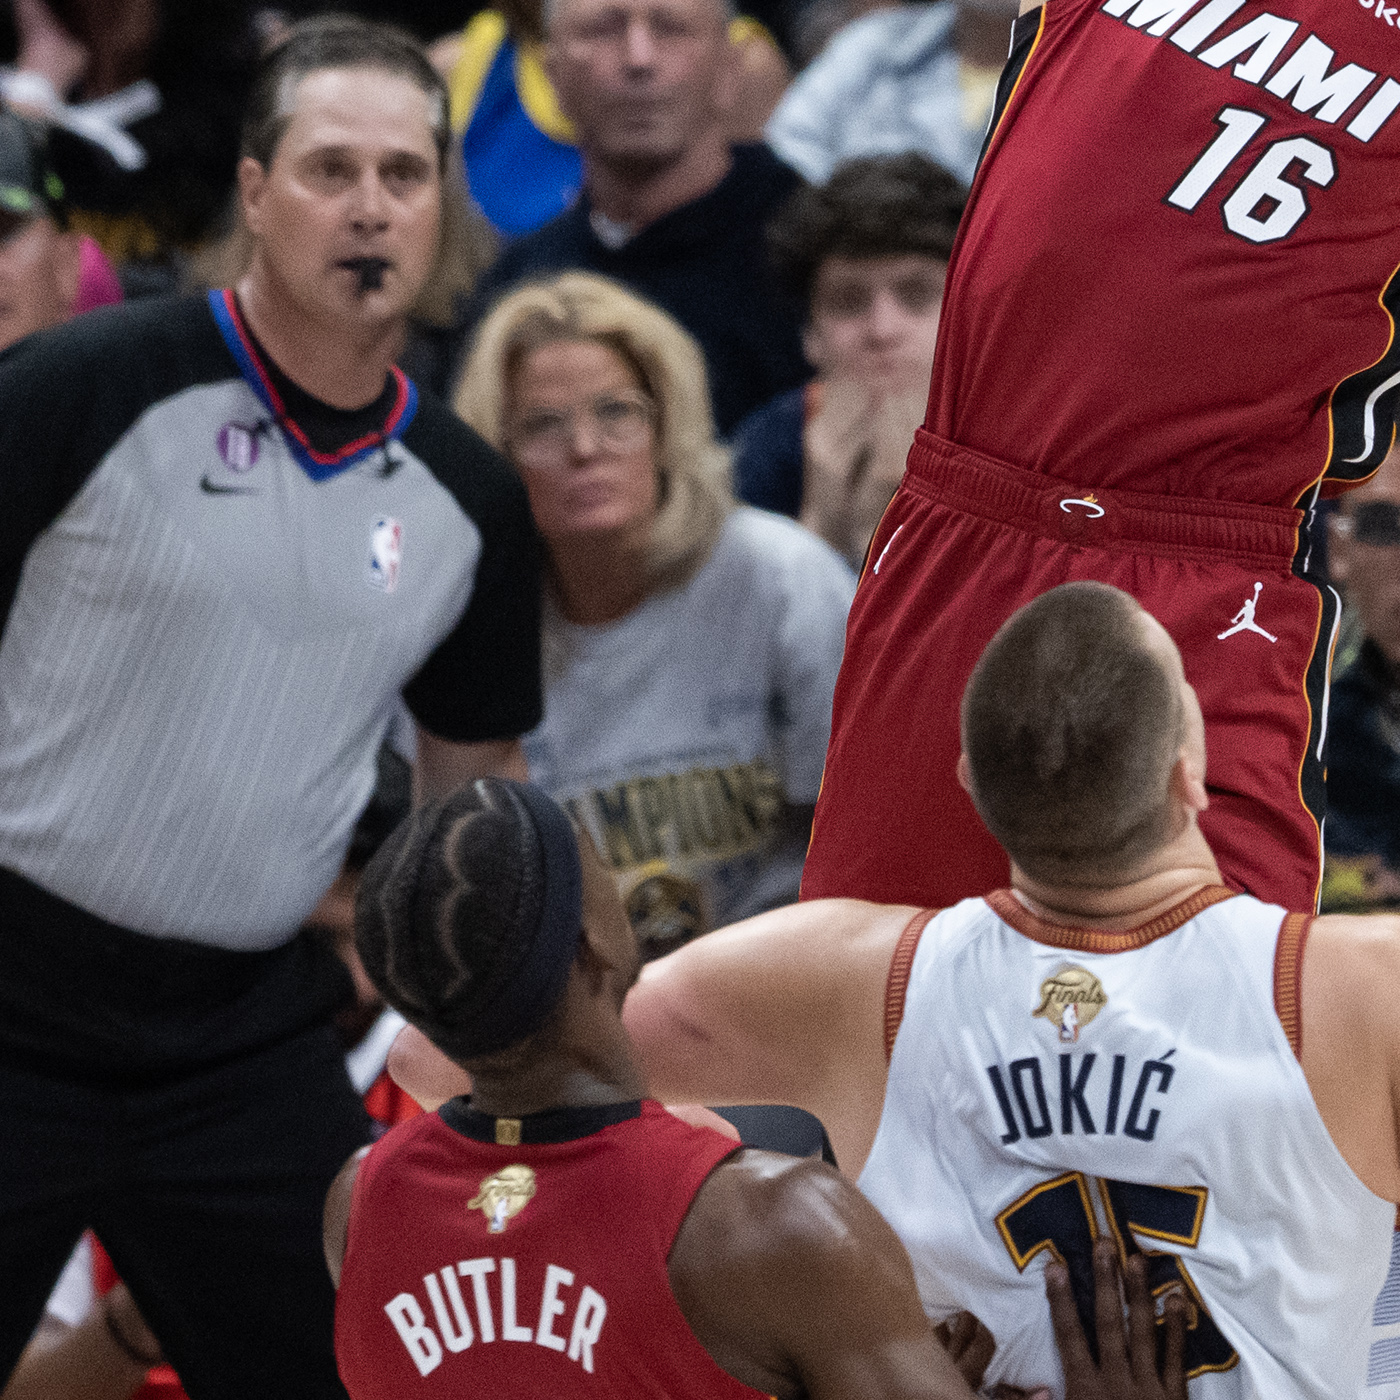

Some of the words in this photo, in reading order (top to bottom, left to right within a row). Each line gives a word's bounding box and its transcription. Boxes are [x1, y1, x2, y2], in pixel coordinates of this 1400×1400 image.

[1161, 104, 1340, 245] 16
[1032, 976, 1107, 1018] Finals
[986, 1047, 1177, 1145] JOKIĆ
[383, 1256, 608, 1378] BUTLER
